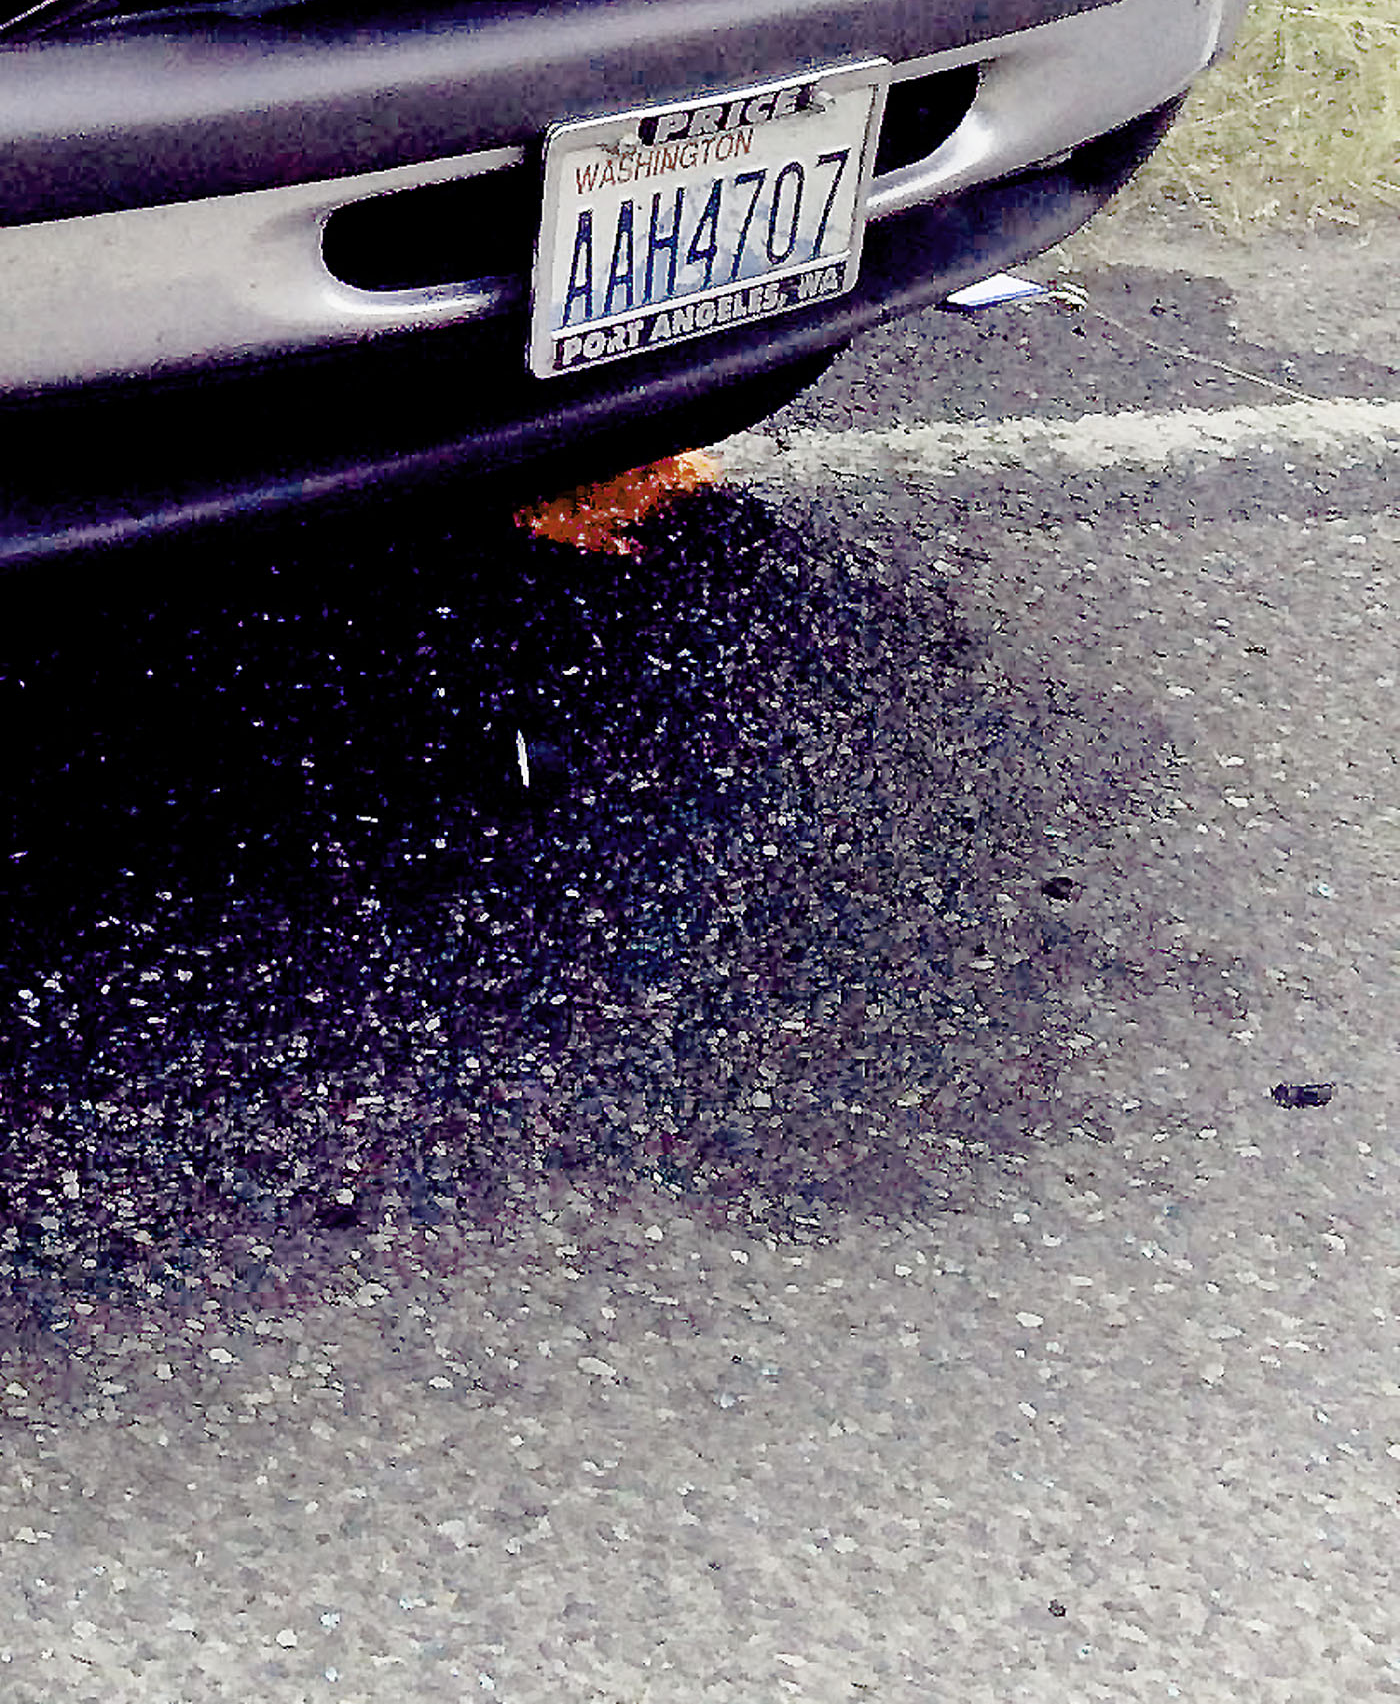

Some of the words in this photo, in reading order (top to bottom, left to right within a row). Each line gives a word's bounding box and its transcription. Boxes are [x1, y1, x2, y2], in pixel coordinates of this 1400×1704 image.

[655, 86, 802, 142] PRICE
[575, 127, 754, 195] WASHINGTON
[561, 147, 852, 328] AAH4707
[562, 320, 645, 365] PORT
